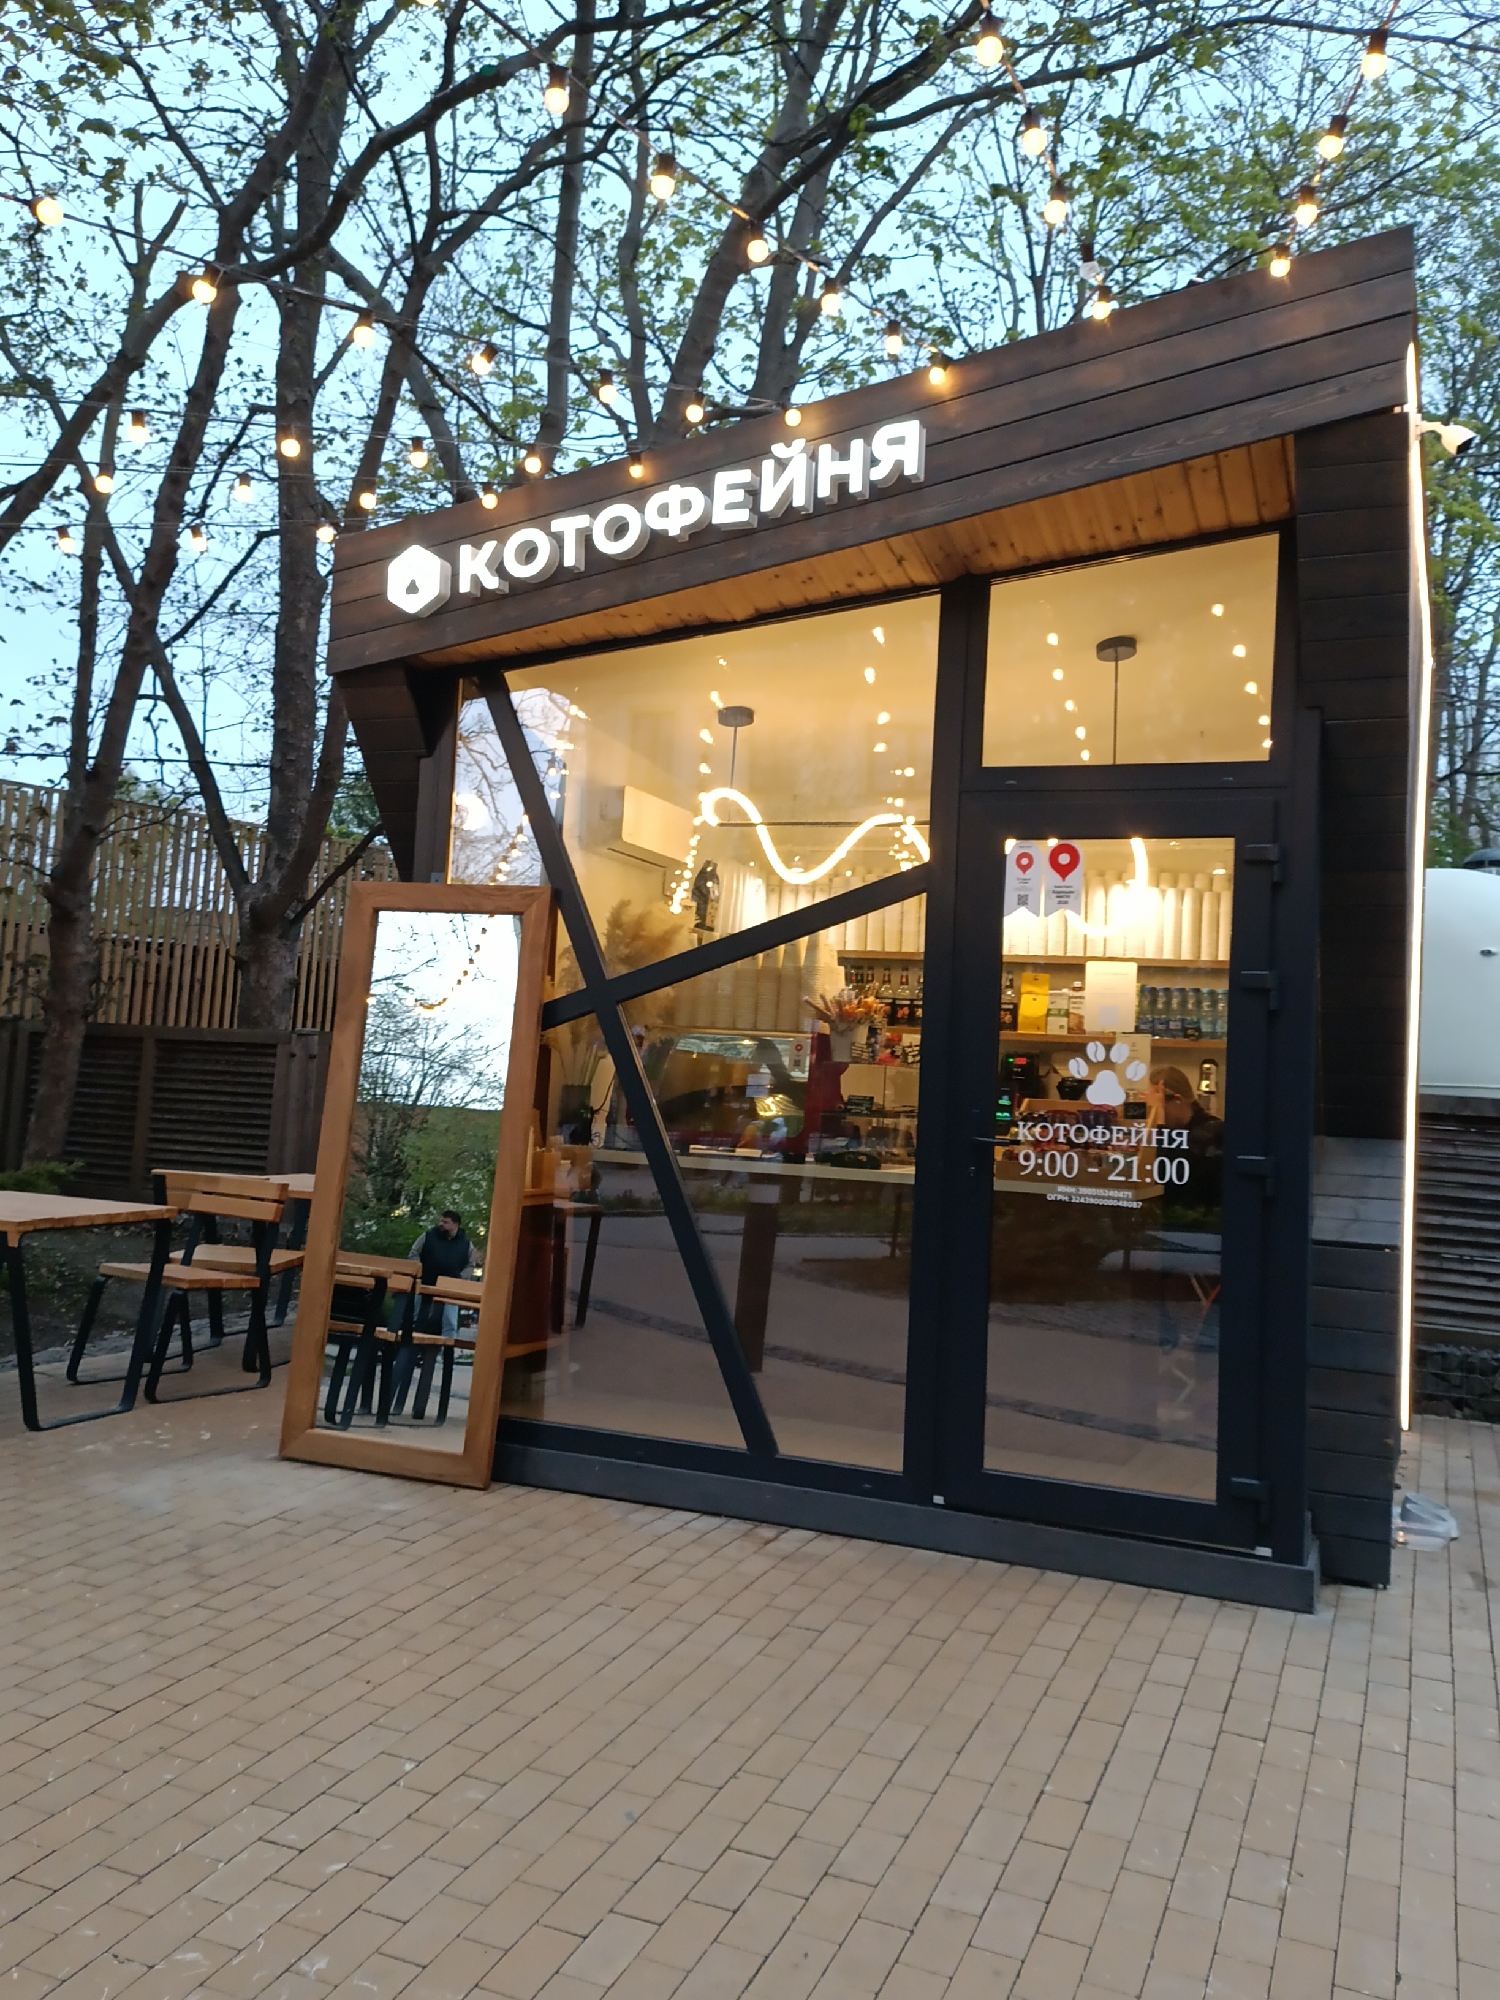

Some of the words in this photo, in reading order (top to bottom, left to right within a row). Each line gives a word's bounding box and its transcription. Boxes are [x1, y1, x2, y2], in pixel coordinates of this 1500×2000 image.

[459, 418, 923, 596] КОТОФЕЙНЯ
[1017, 1121, 1190, 1149] КОТОФЕЙНЯ
[1018, 1150, 1079, 1179] 9:00
[1107, 1154, 1190, 1185] 21:00
[1046, 1193, 1071, 1202] ОГРН:
